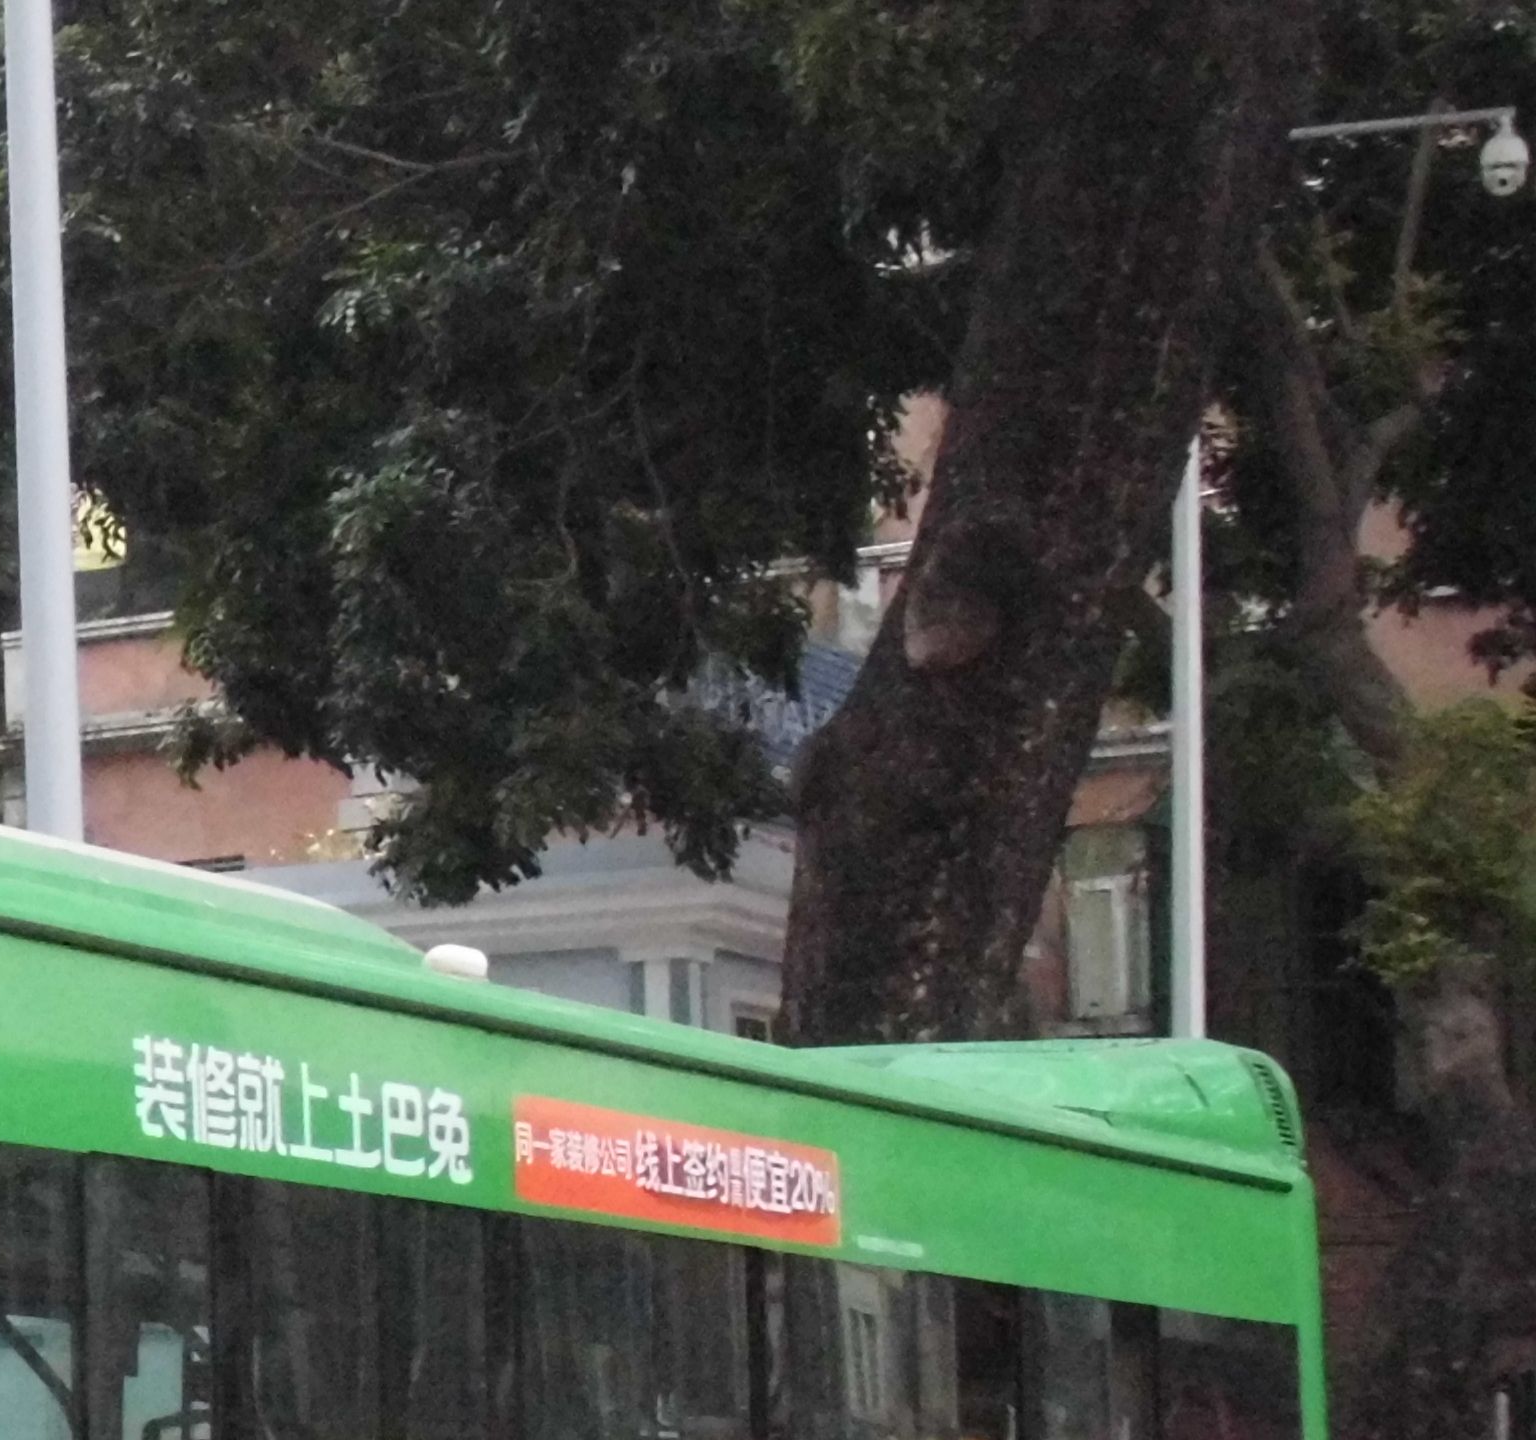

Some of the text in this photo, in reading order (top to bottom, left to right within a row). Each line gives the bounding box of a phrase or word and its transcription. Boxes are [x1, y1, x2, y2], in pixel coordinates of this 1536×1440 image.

[132, 1034, 474, 1185] 装修就上土巴兔
